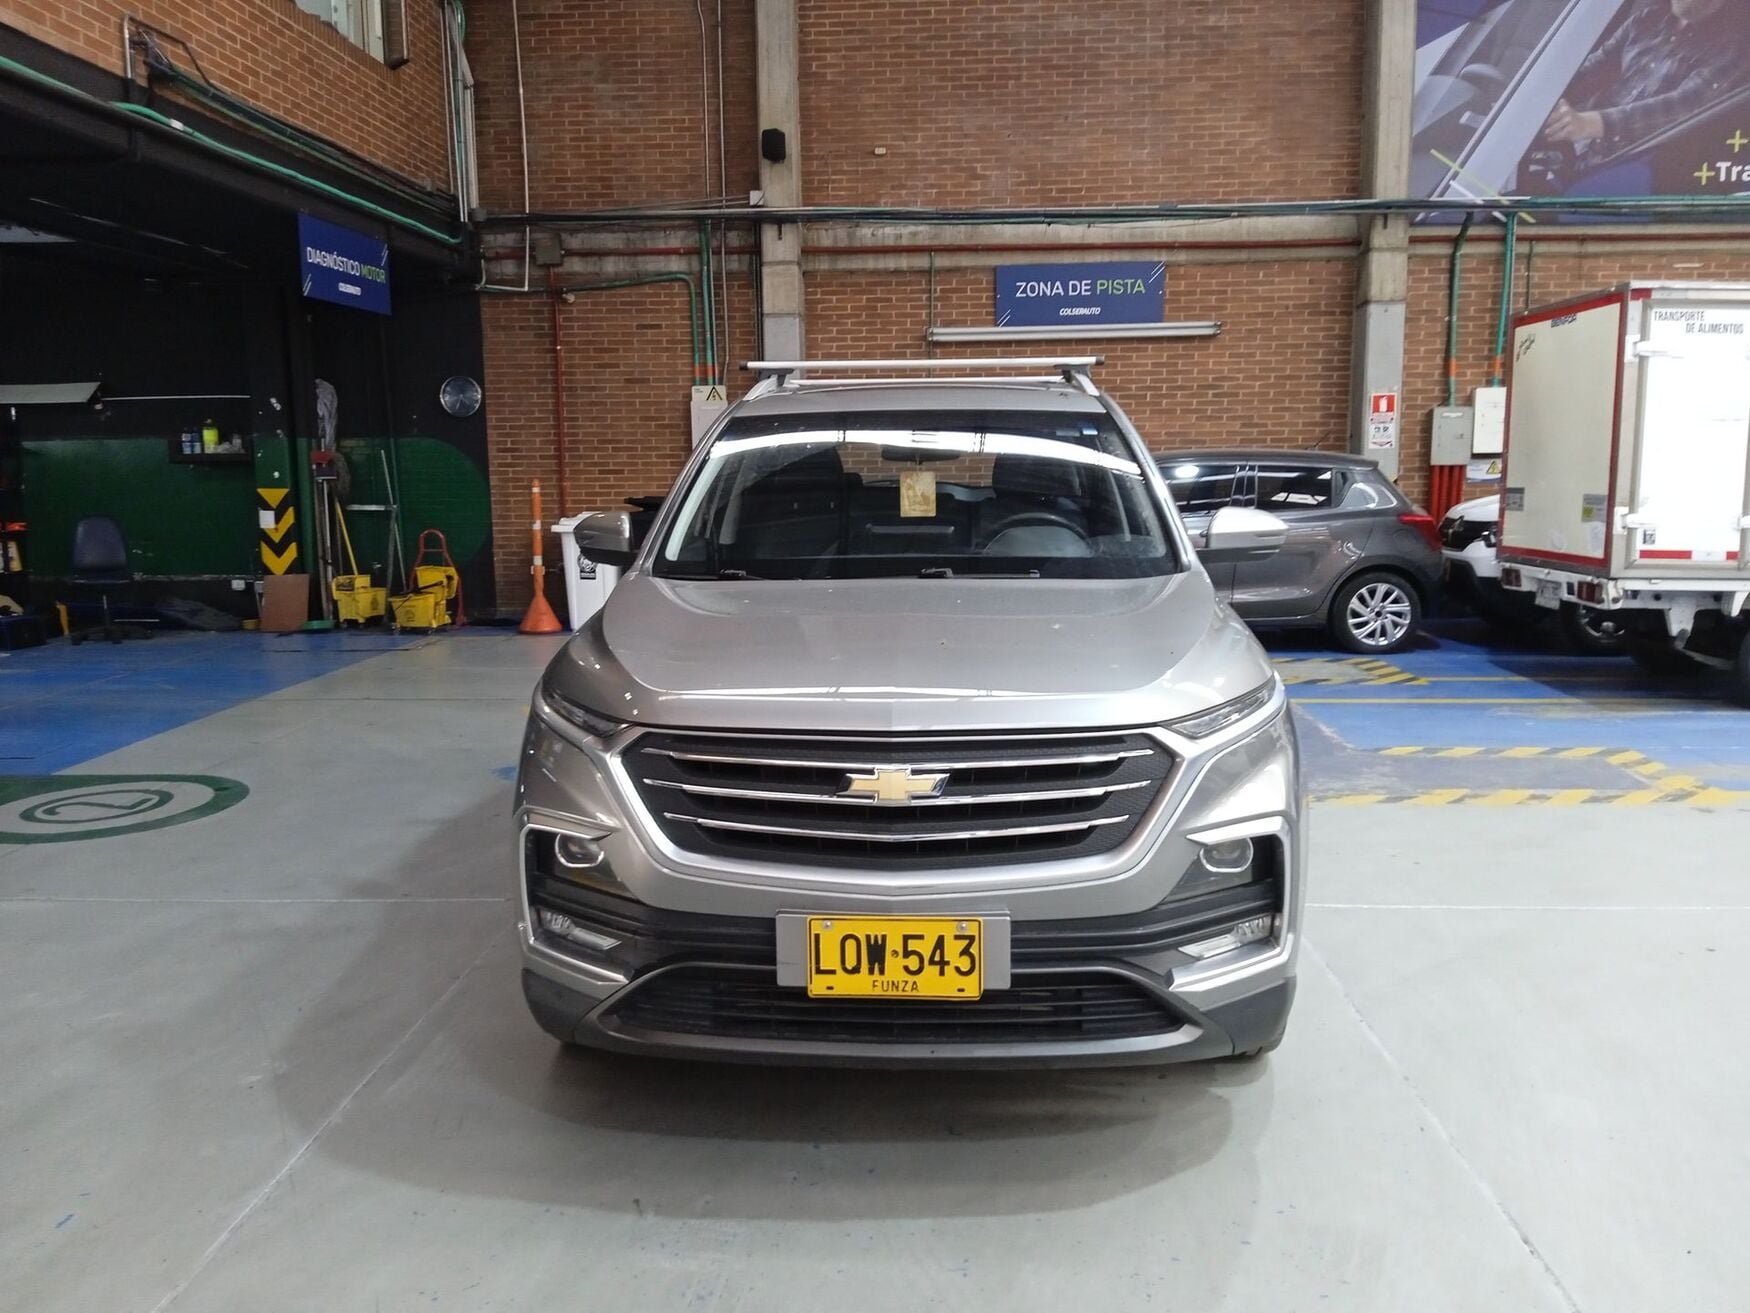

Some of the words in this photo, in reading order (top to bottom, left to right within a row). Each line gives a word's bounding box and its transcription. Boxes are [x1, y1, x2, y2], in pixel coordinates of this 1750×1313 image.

[306, 246, 360, 277] DIAGNÓSTICO
[361, 263, 386, 284] MOTOR
[1015, 280, 1064, 297] ZONA
[1068, 280, 1092, 296] DE
[1096, 278, 1146, 295] PISTA
[1654, 310, 1704, 321] TRANSPORTE
[1685, 322, 1696, 334] DE
[1698, 323, 1744, 335] ALIMENTOS
[902, 934, 976, 977] 543
[872, 979, 920, 993] FUNZA
